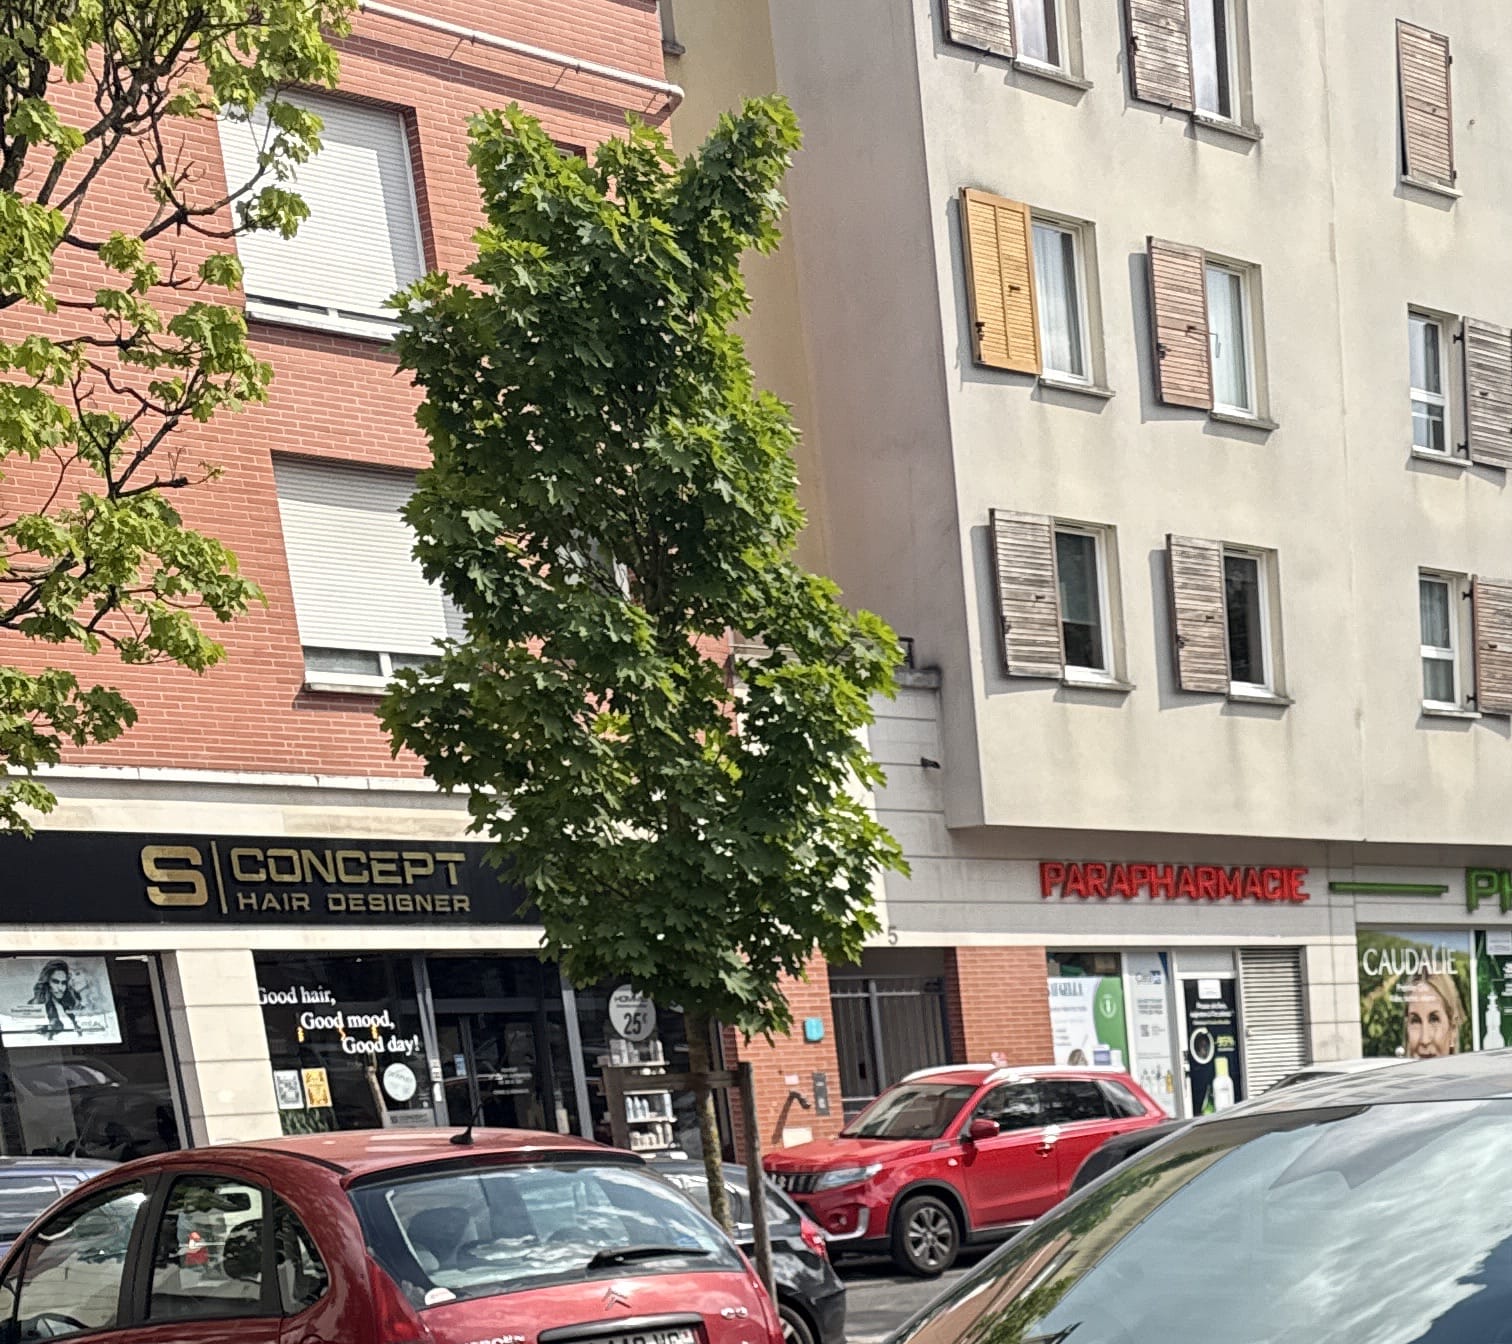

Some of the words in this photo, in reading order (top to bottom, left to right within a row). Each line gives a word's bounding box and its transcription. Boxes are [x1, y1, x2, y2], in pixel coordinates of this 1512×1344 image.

[230, 847, 466, 886] CONCEPT
[1038, 861, 1310, 901] PARAPHARMACIE
[237, 891, 310, 911] HAIR
[327, 892, 471, 913] DESIGNER
[888, 926, 898, 945] 5
[257, 986, 298, 1005] Good
[300, 985, 336, 1006] hair,
[300, 1011, 344, 1030] Good
[347, 1009, 396, 1030] mood,
[341, 1035, 384, 1054] Good
[387, 1034, 420, 1056] day!
